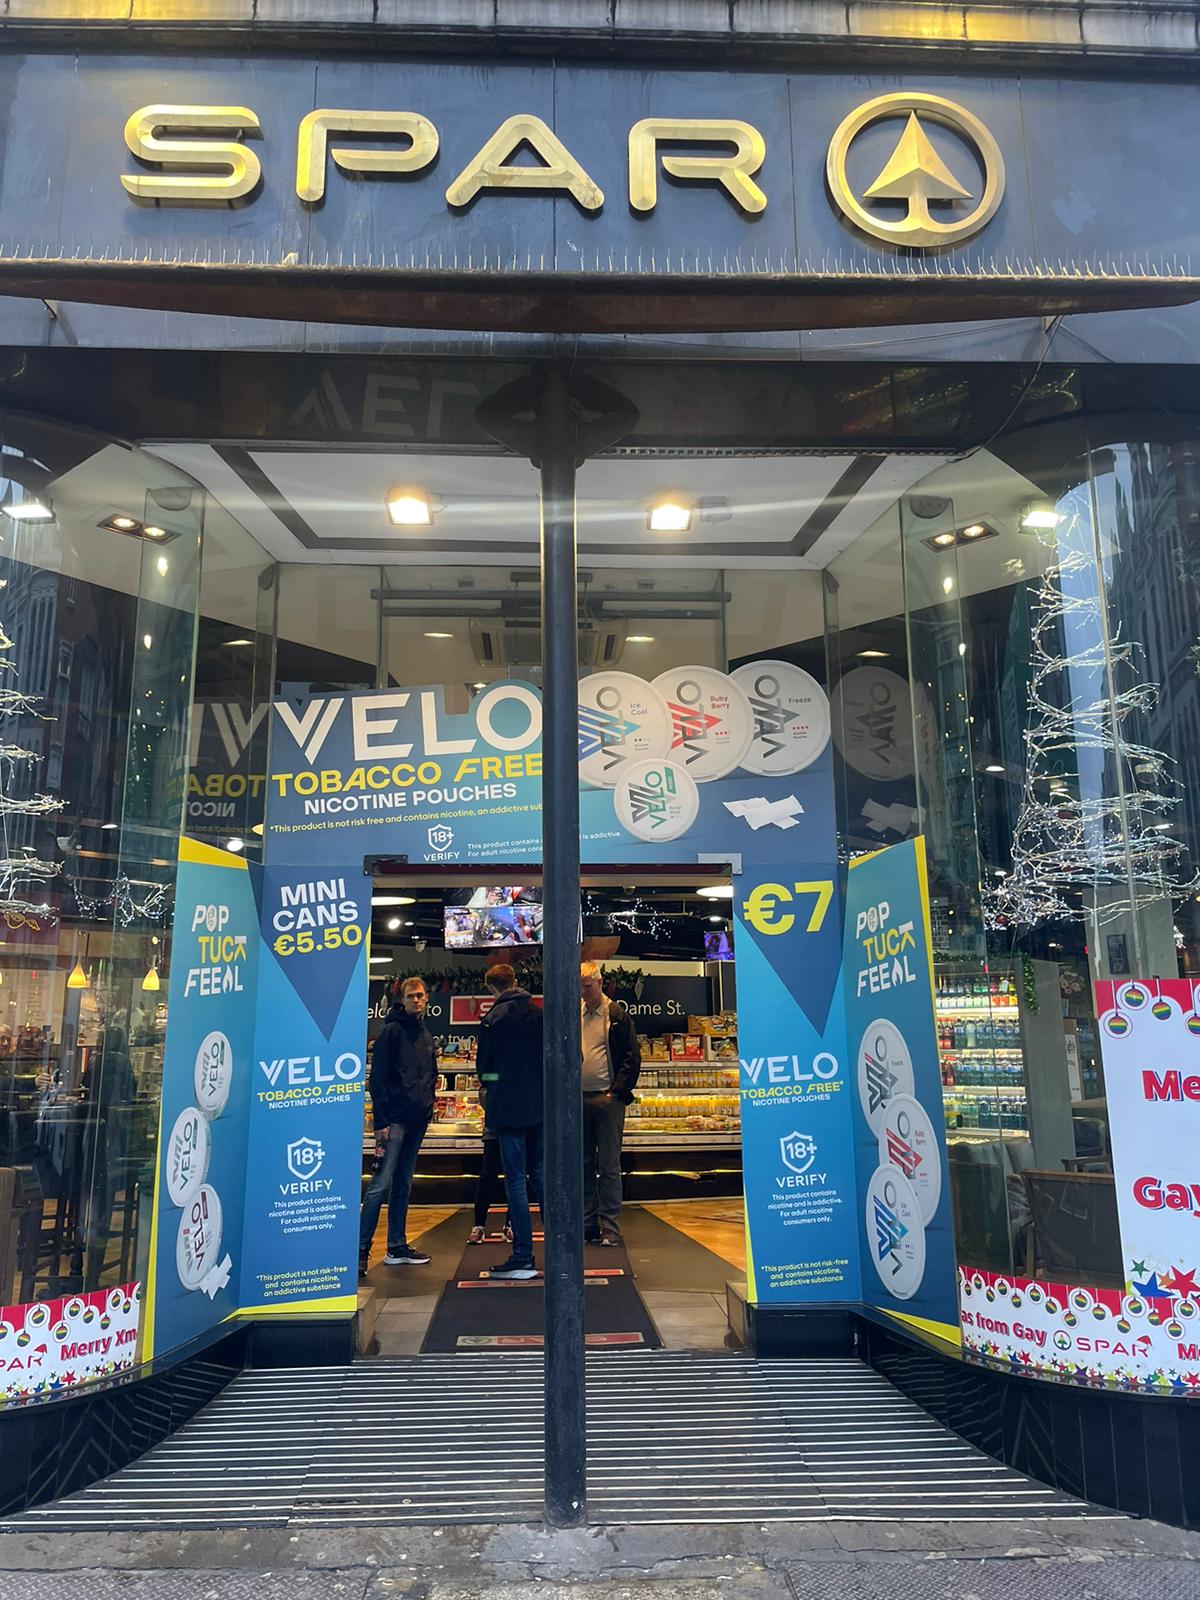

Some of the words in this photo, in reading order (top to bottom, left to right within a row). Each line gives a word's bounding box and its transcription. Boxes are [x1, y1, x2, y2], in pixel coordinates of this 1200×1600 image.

[120, 103, 767, 213] SPAR
[710, 695, 728, 704] Ruby
[711, 702, 730, 710] Berry
[272, 685, 543, 766] VELO
[272, 762, 442, 797] TOBACCO
[454, 753, 543, 782] FREE
[304, 790, 407, 815] NICOTINE
[412, 783, 517, 806] POUCHES
[292, 822, 327, 832] product
[327, 820, 334, 829] is
[335, 819, 350, 827] not
[351, 818, 365, 826] risk
[366, 816, 384, 825] free
[385, 814, 402, 823] and
[403, 810, 439, 821] contains
[489, 804, 528, 815] addictive
[432, 831, 454, 843] 18+
[483, 840, 510, 849] product
[511, 838, 539, 846] contains
[423, 851, 460, 861] VERIFY
[480, 847, 498, 856] adult
[499, 846, 526, 855] nicotine
[280, 878, 346, 907] MINI
[742, 880, 834, 936] €7
[273, 900, 359, 932] CANS
[273, 924, 362, 957] €5.50
[426, 1005, 442, 1016] to
[616, 1000, 661, 1015] Dame
[666, 999, 686, 1015] St.
[208, 1042, 220, 1096] VELO
[260, 1052, 361, 1086] VELO
[739, 1052, 838, 1085] VELO
[257, 1086, 322, 1103] TOBACCO
[740, 1085, 802, 1101] TOBACCO
[752, 1096, 790, 1107] NICOTINE
[791, 1093, 831, 1103] POUCHES
[268, 1098, 308, 1110] NICOTINE
[310, 1094, 350, 1105] POUCHES
[180, 1121, 193, 1190] VELO
[293, 1147, 326, 1166] 18+
[786, 1141, 817, 1160] 18+
[279, 1179, 333, 1196] VERIFY
[776, 1173, 827, 1188] VERIFY
[274, 1201, 287, 1209] This
[287, 1198, 313, 1208] product
[314, 1195, 342, 1204] contains
[785, 1192, 809, 1200] product
[810, 1189, 837, 1198] contains
[268, 1209, 295, 1218] nicotine
[767, 1202, 793, 1210] nicotine
[808, 1207, 833, 1215] nicotine
[292, 1216, 309, 1224] adult
[310, 1214, 336, 1222] nicotine
[783, 1218, 817, 1226] consumers
[283, 1224, 318, 1234] consumers
[777, 1263, 803, 1272] product
[785, 1270, 813, 1279] contains
[273, 1271, 300, 1280] product
[780, 1278, 810, 1287] addictive
[811, 1275, 844, 1284] substance
[265, 1281, 278, 1289] and
[281, 1278, 310, 1287] contains
[274, 1286, 306, 1296] addictive
[306, 1283, 341, 1292] substance
[975, 1313, 1009, 1336] from
[1013, 1322, 1047, 1348] Gay
[1076, 1336, 1149, 1358] SPAR
[61, 1336, 112, 1361] Merry
